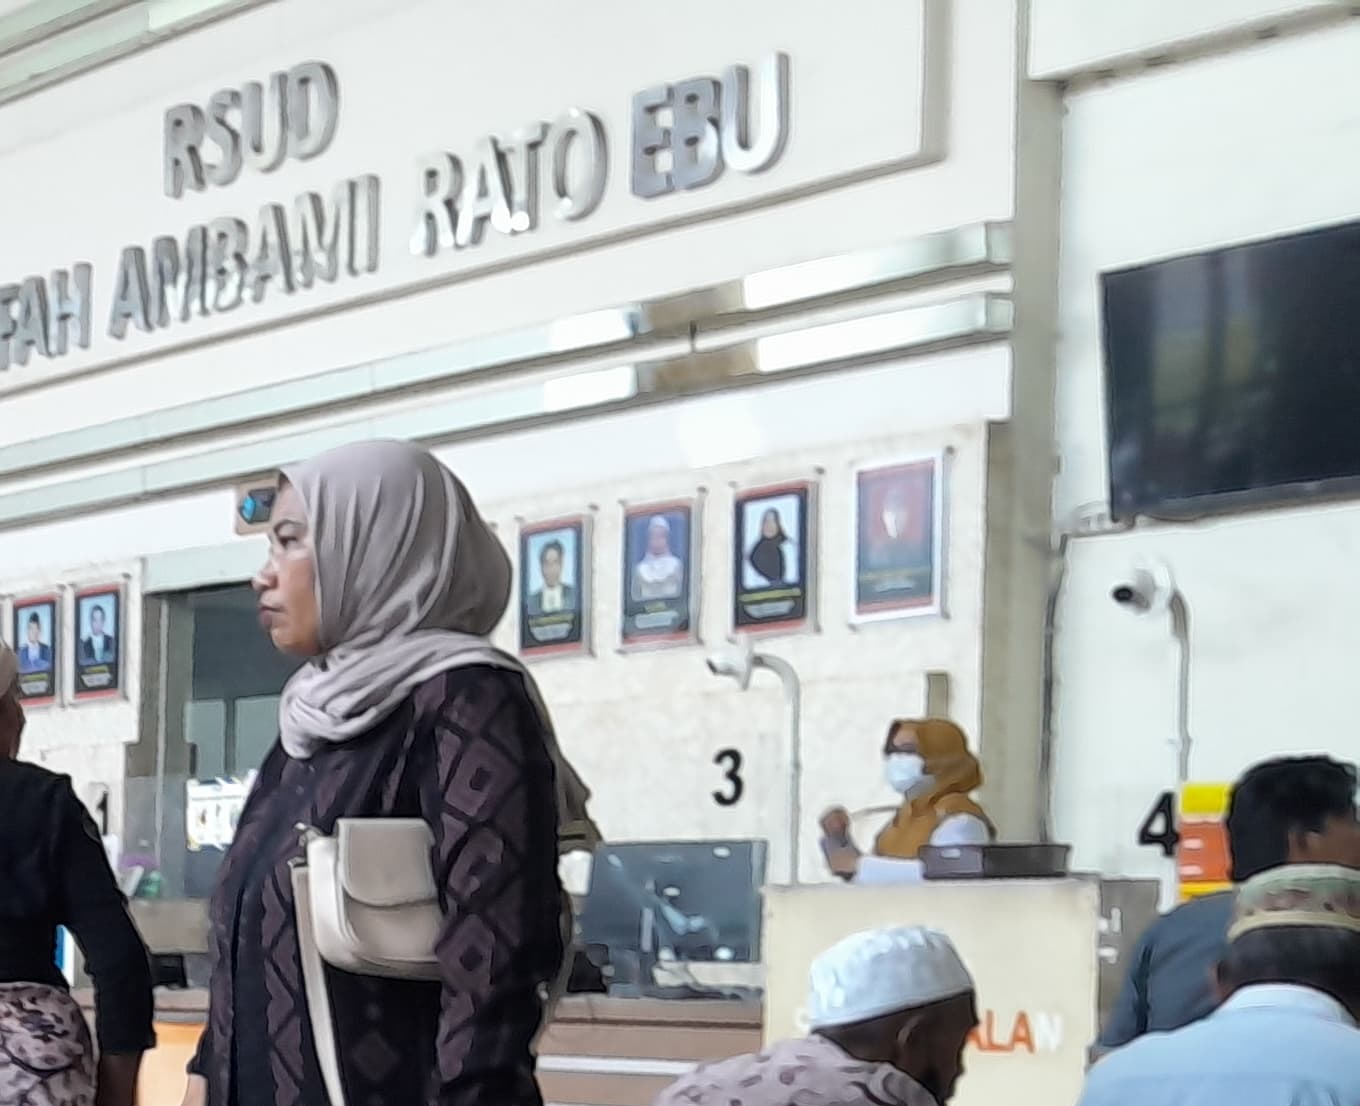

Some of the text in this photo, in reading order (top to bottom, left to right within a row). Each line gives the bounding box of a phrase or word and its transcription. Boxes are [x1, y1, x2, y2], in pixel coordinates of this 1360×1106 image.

[163, 59, 340, 199] RSUD
[106, 173, 381, 340] AMBAMI
[407, 107, 610, 257] RATO
[630, 50, 792, 199] EBU
[711, 747, 744, 807] 3
[1138, 791, 1180, 857] 4
